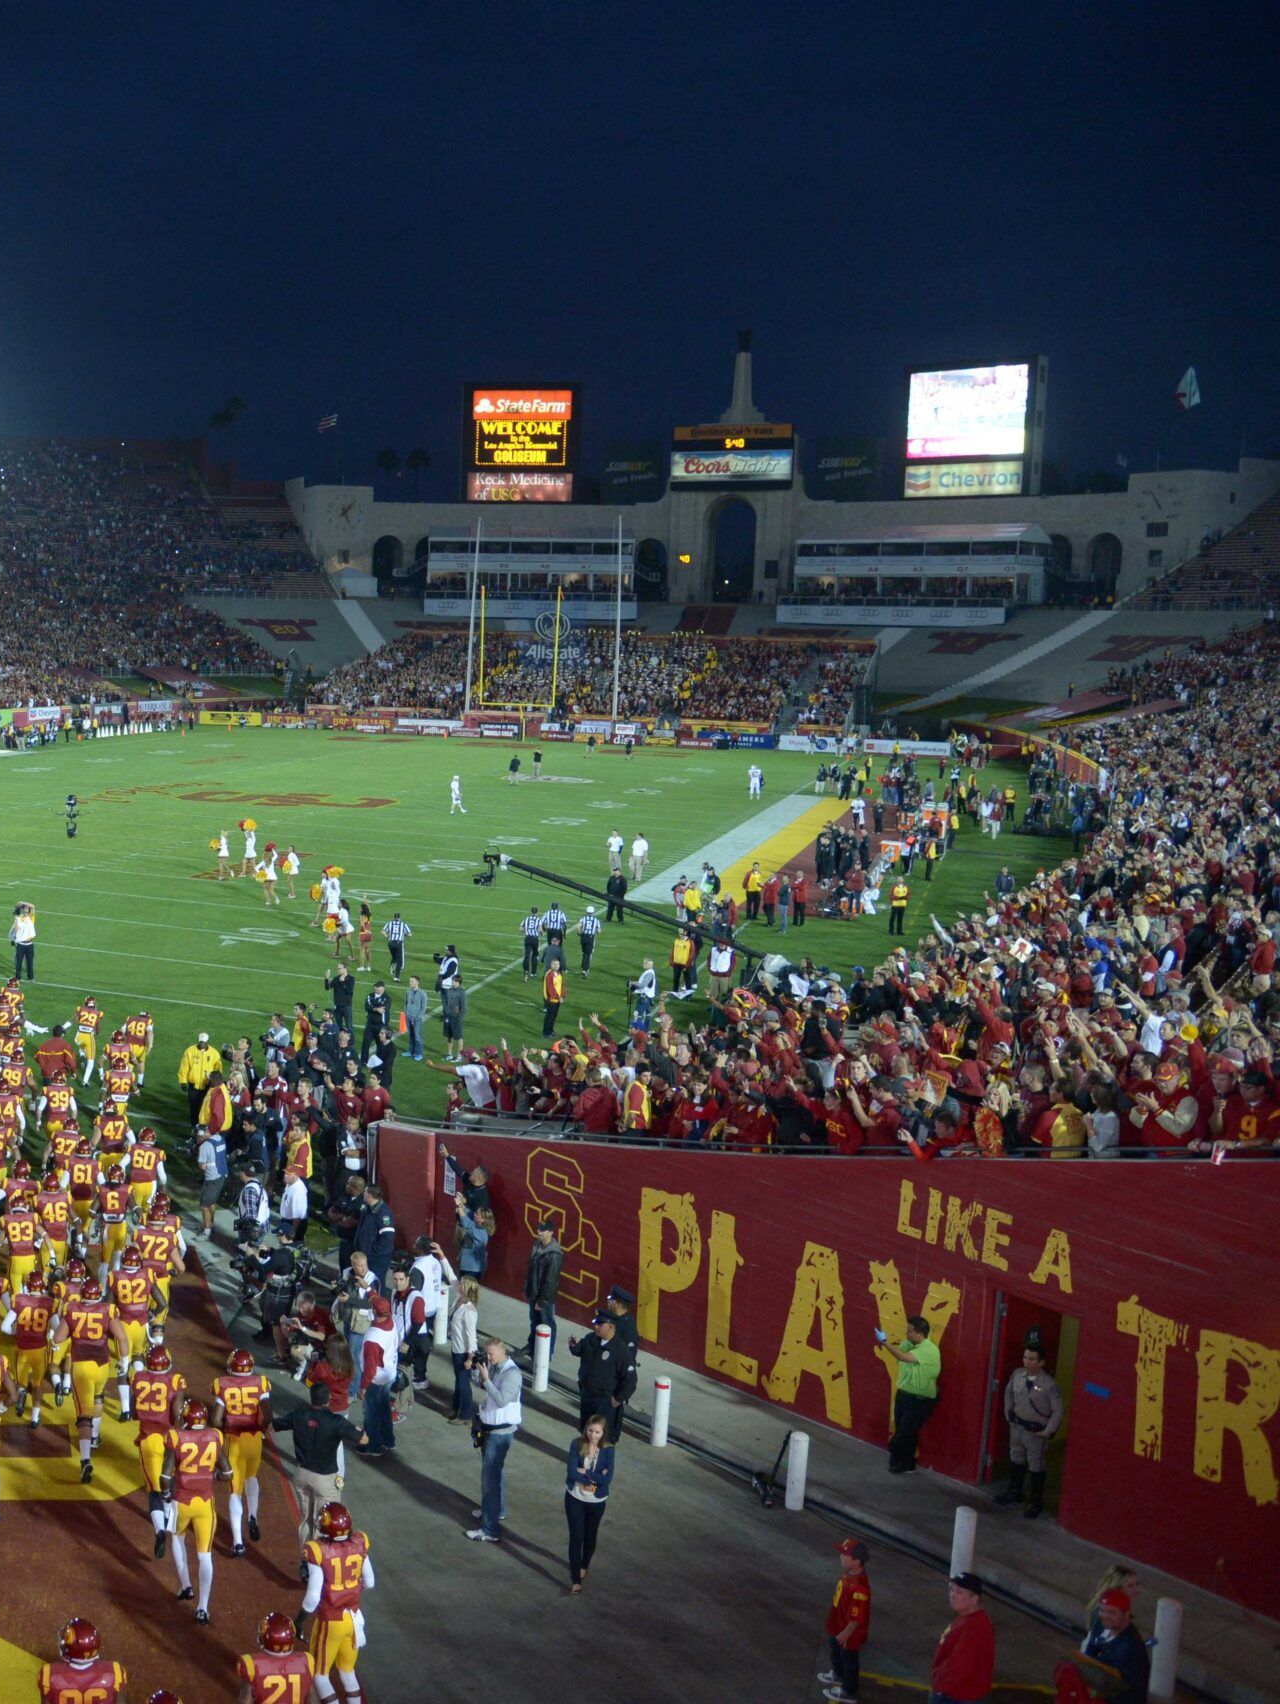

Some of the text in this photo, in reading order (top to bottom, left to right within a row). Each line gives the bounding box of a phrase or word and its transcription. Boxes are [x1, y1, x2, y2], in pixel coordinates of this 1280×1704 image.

[481, 420, 562, 435] WELCOME
[494, 451, 547, 462] COLISEUM
[684, 455, 780, 474] Coors LIGHT
[818, 457, 868, 469] SUBWAY
[606, 461, 652, 472] SUBWAY
[475, 473, 565, 485] Keck Medicine
[938, 471, 1021, 488] Chevron
[475, 488, 490, 500] of
[525, 644, 581, 660] Allsate
[35, 709, 59, 719] Chevron
[726, 735, 765, 743] FRMERS
[79, 1012, 97, 1028] 29
[127, 1020, 146, 1038] 48
[0, 1038, 15, 1054] 14
[2, 1070, 22, 1087] 99
[111, 1078, 130, 1093] 26
[49, 1091, 69, 1108] 39
[103, 1120, 124, 1140] 47
[1238, 1114, 1259, 1141] 9
[54, 1137, 77, 1155] 37
[132, 1149, 156, 1171] 60
[73, 1163, 93, 1185] 61
[106, 1191, 120, 1210] 6
[42, 1202, 68, 1223] 46
[7, 1222, 34, 1243] 83
[896, 1178, 1073, 1294] LIKE A
[141, 1234, 170, 1261] 72
[117, 1278, 148, 1305] 82
[17, 1305, 49, 1332] 48
[71, 1311, 104, 1340] 75
[636, 1186, 961, 1457] PLAY
[135, 1380, 168, 1412] 23
[224, 1386, 259, 1416] 85
[1116, 1294, 1280, 1507] TR
[180, 1441, 218, 1474] 24
[330, 1553, 363, 1592] 13
[262, 1673, 302, 1704] 21
